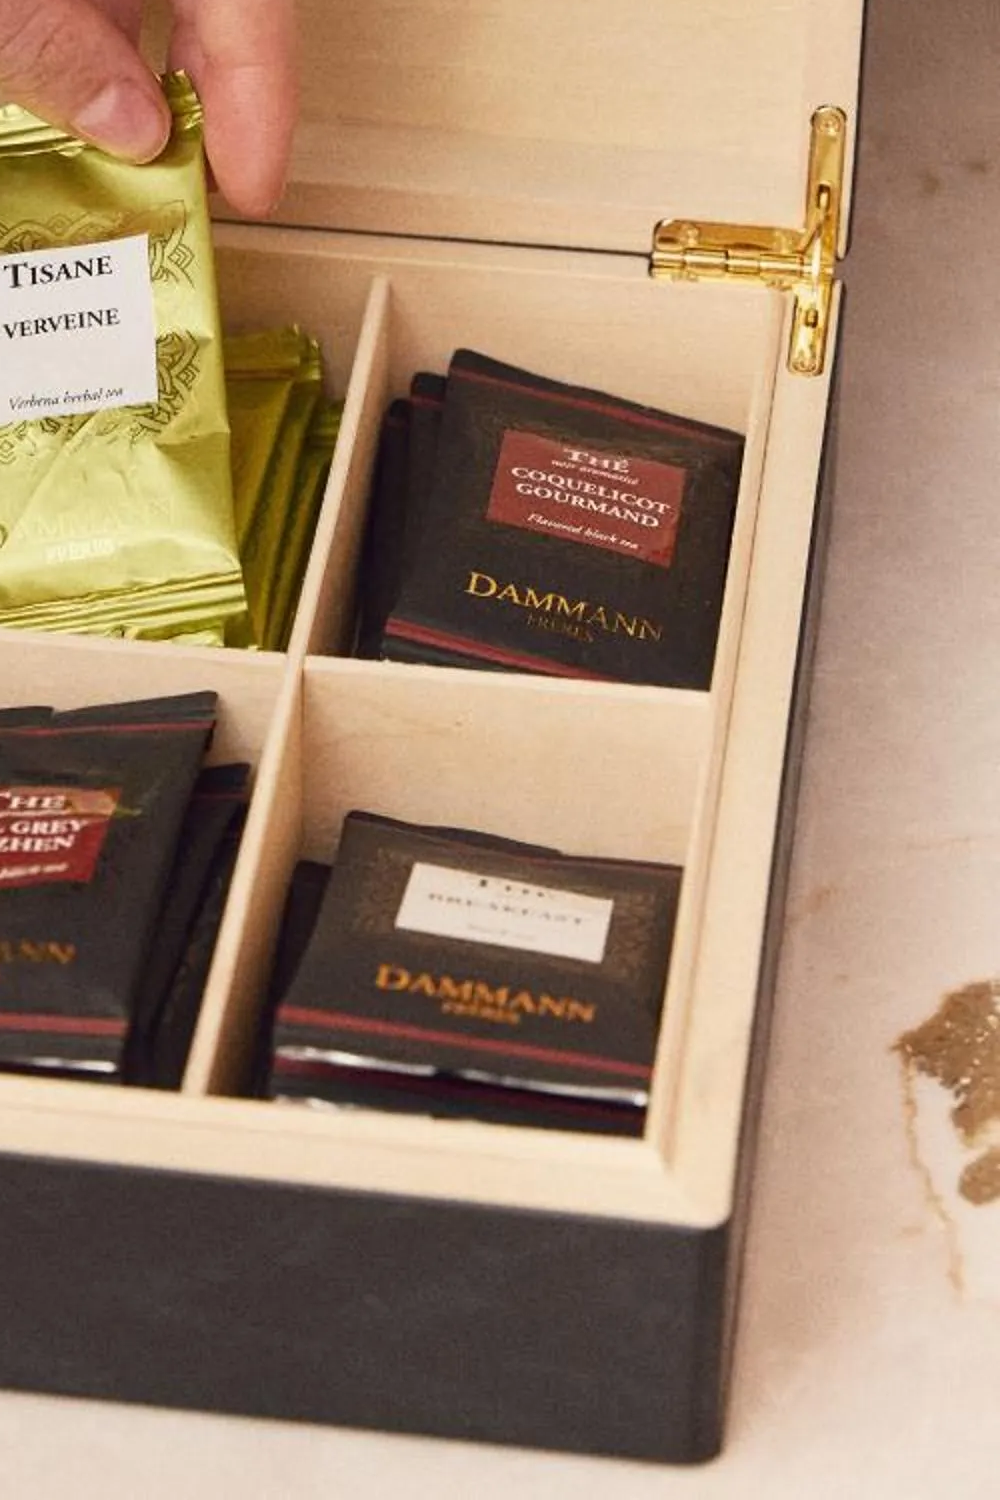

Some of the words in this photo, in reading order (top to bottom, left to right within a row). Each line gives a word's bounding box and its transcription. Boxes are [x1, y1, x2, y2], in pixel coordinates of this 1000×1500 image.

[4, 255, 112, 289] TISANE
[3, 308, 120, 339] VERVEINE
[511, 467, 671, 514] COQUELICOT
[516, 483, 660, 528] GOURMAND
[463, 571, 663, 641] DAMMANN
[9, 819, 88, 835] GREY
[375, 963, 598, 1024] DAMMANN
